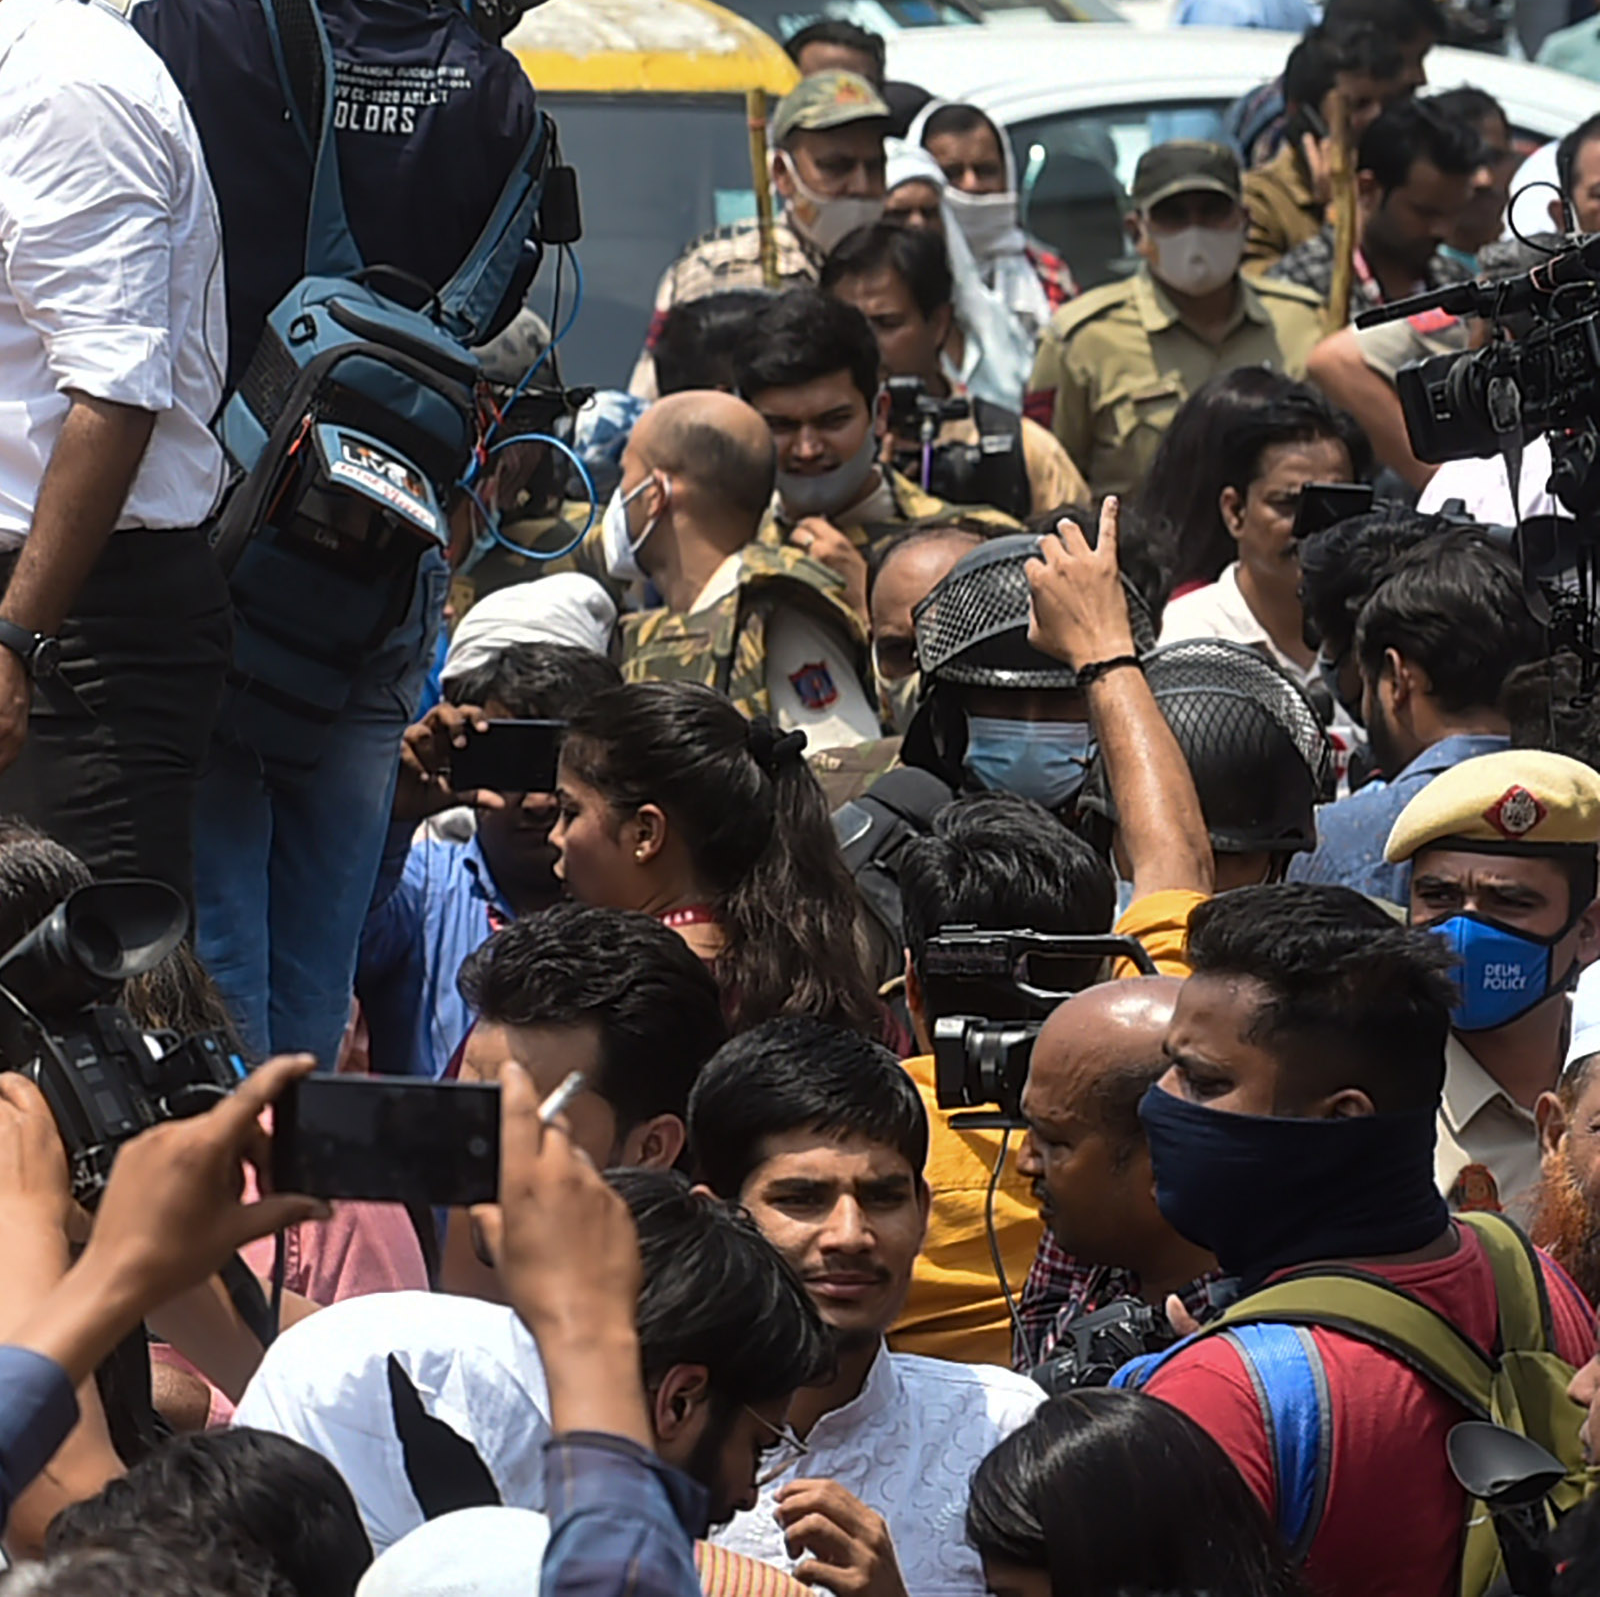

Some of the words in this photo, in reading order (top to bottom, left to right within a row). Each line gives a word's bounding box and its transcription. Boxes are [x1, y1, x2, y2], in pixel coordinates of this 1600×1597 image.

[333, 100, 416, 133] OLORS
[1484, 963, 1521, 977] DELHI
[1483, 975, 1527, 991] POLICE
